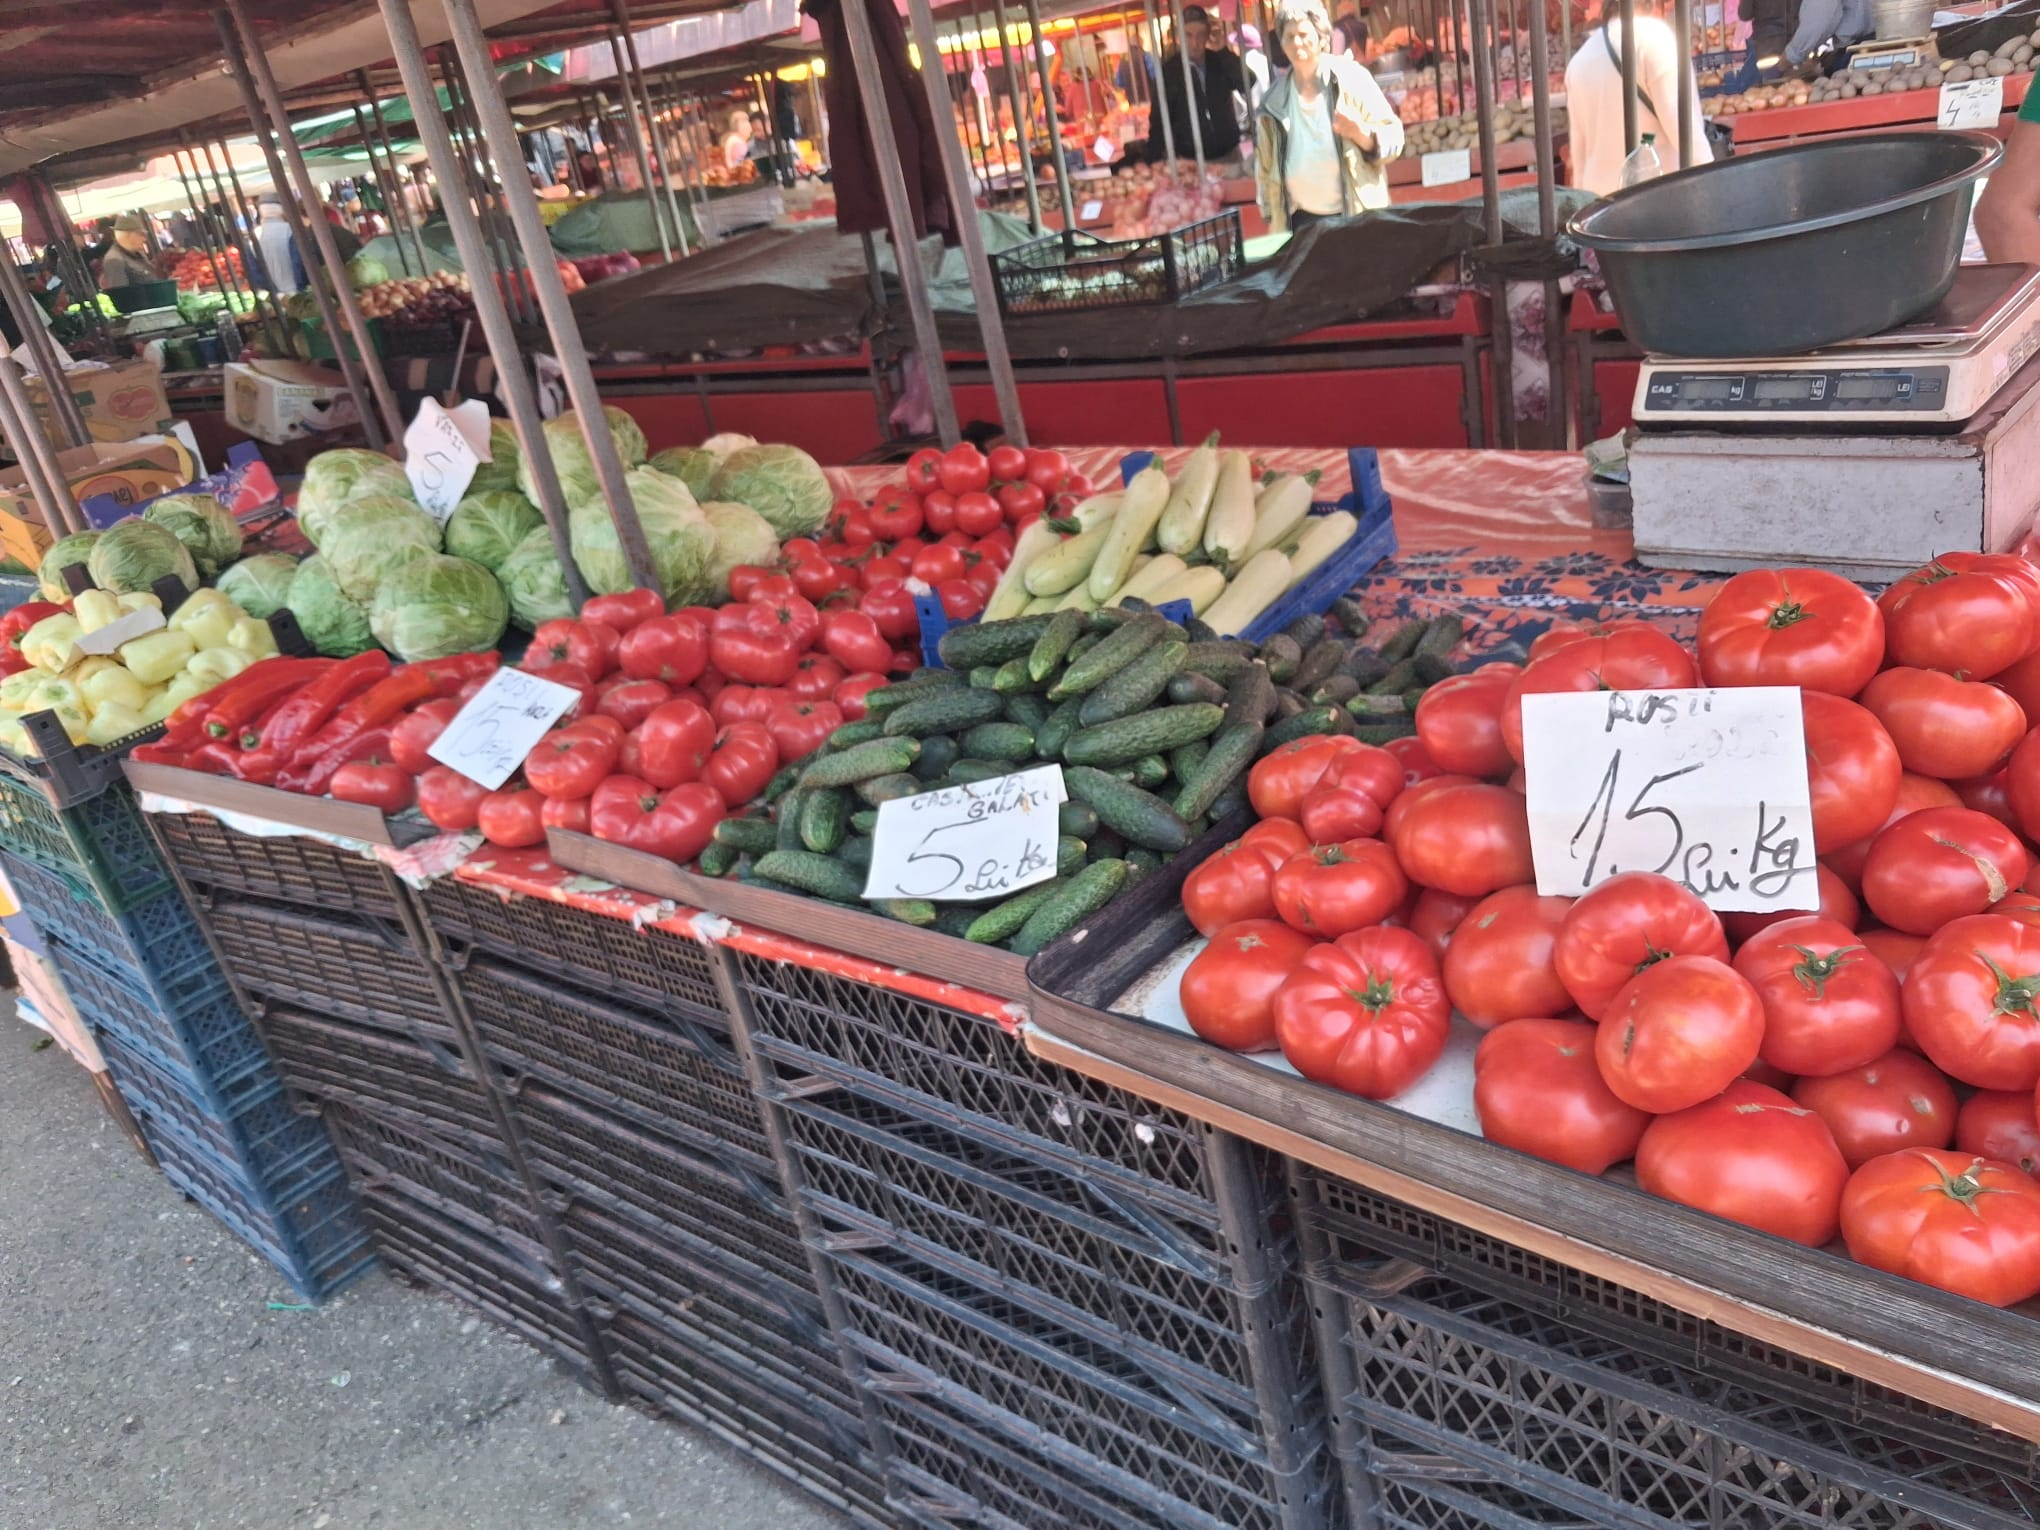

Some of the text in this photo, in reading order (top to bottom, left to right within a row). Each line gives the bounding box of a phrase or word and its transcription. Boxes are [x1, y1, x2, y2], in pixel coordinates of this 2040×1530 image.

[1651, 384, 1673, 394] CAS
[421, 450, 454, 491] 5
[895, 816, 988, 896] 5
